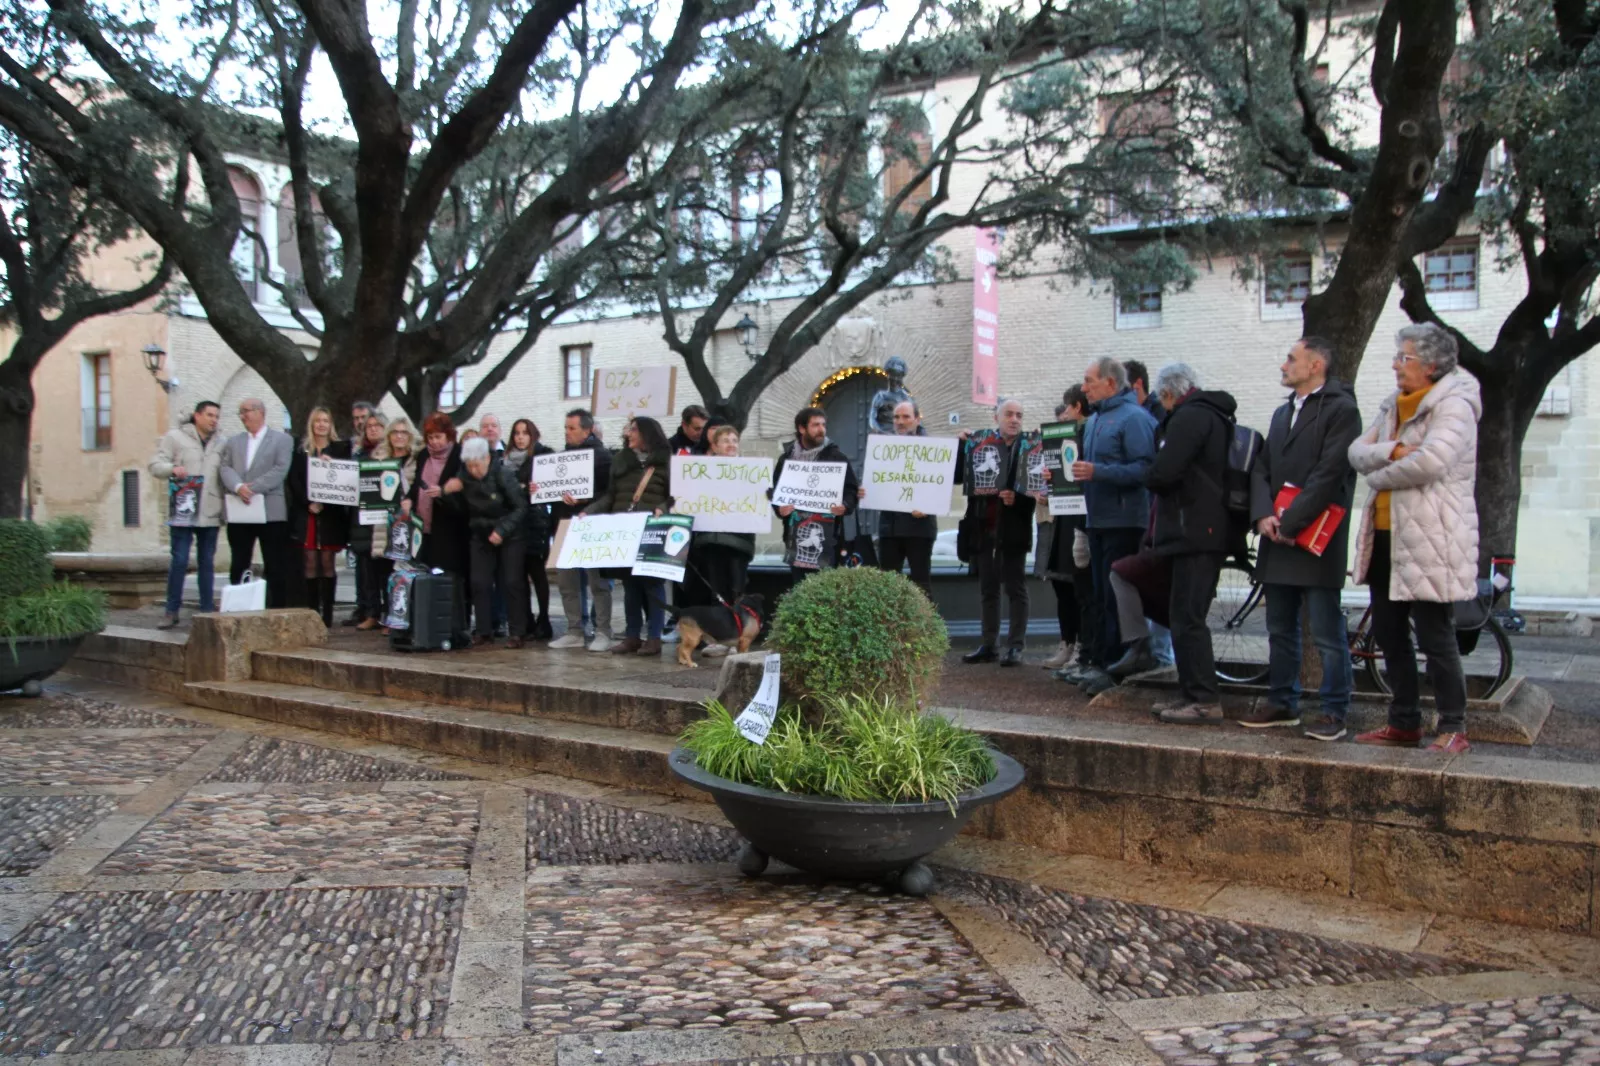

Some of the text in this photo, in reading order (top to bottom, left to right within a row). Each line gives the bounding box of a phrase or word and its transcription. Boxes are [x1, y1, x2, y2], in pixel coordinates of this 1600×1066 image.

[951, 414, 957, 423] 4
[557, 453, 590, 463] RECORTE
[329, 462, 359, 471] RECORTE
[788, 464, 843, 474] NO AL RECORTE
[904, 460, 916, 472] AL
[682, 462, 771, 484] POR JUSTICIA
[872, 471, 944, 485] DESARROLLO
[317, 493, 356, 503] DESARROLLO
[536, 492, 543, 500] AL
[898, 486, 913, 502] YA
[776, 496, 787, 504] AL
[572, 520, 593, 533] LOS
[580, 529, 640, 543] RECORTES
[568, 547, 629, 564] MATAN
